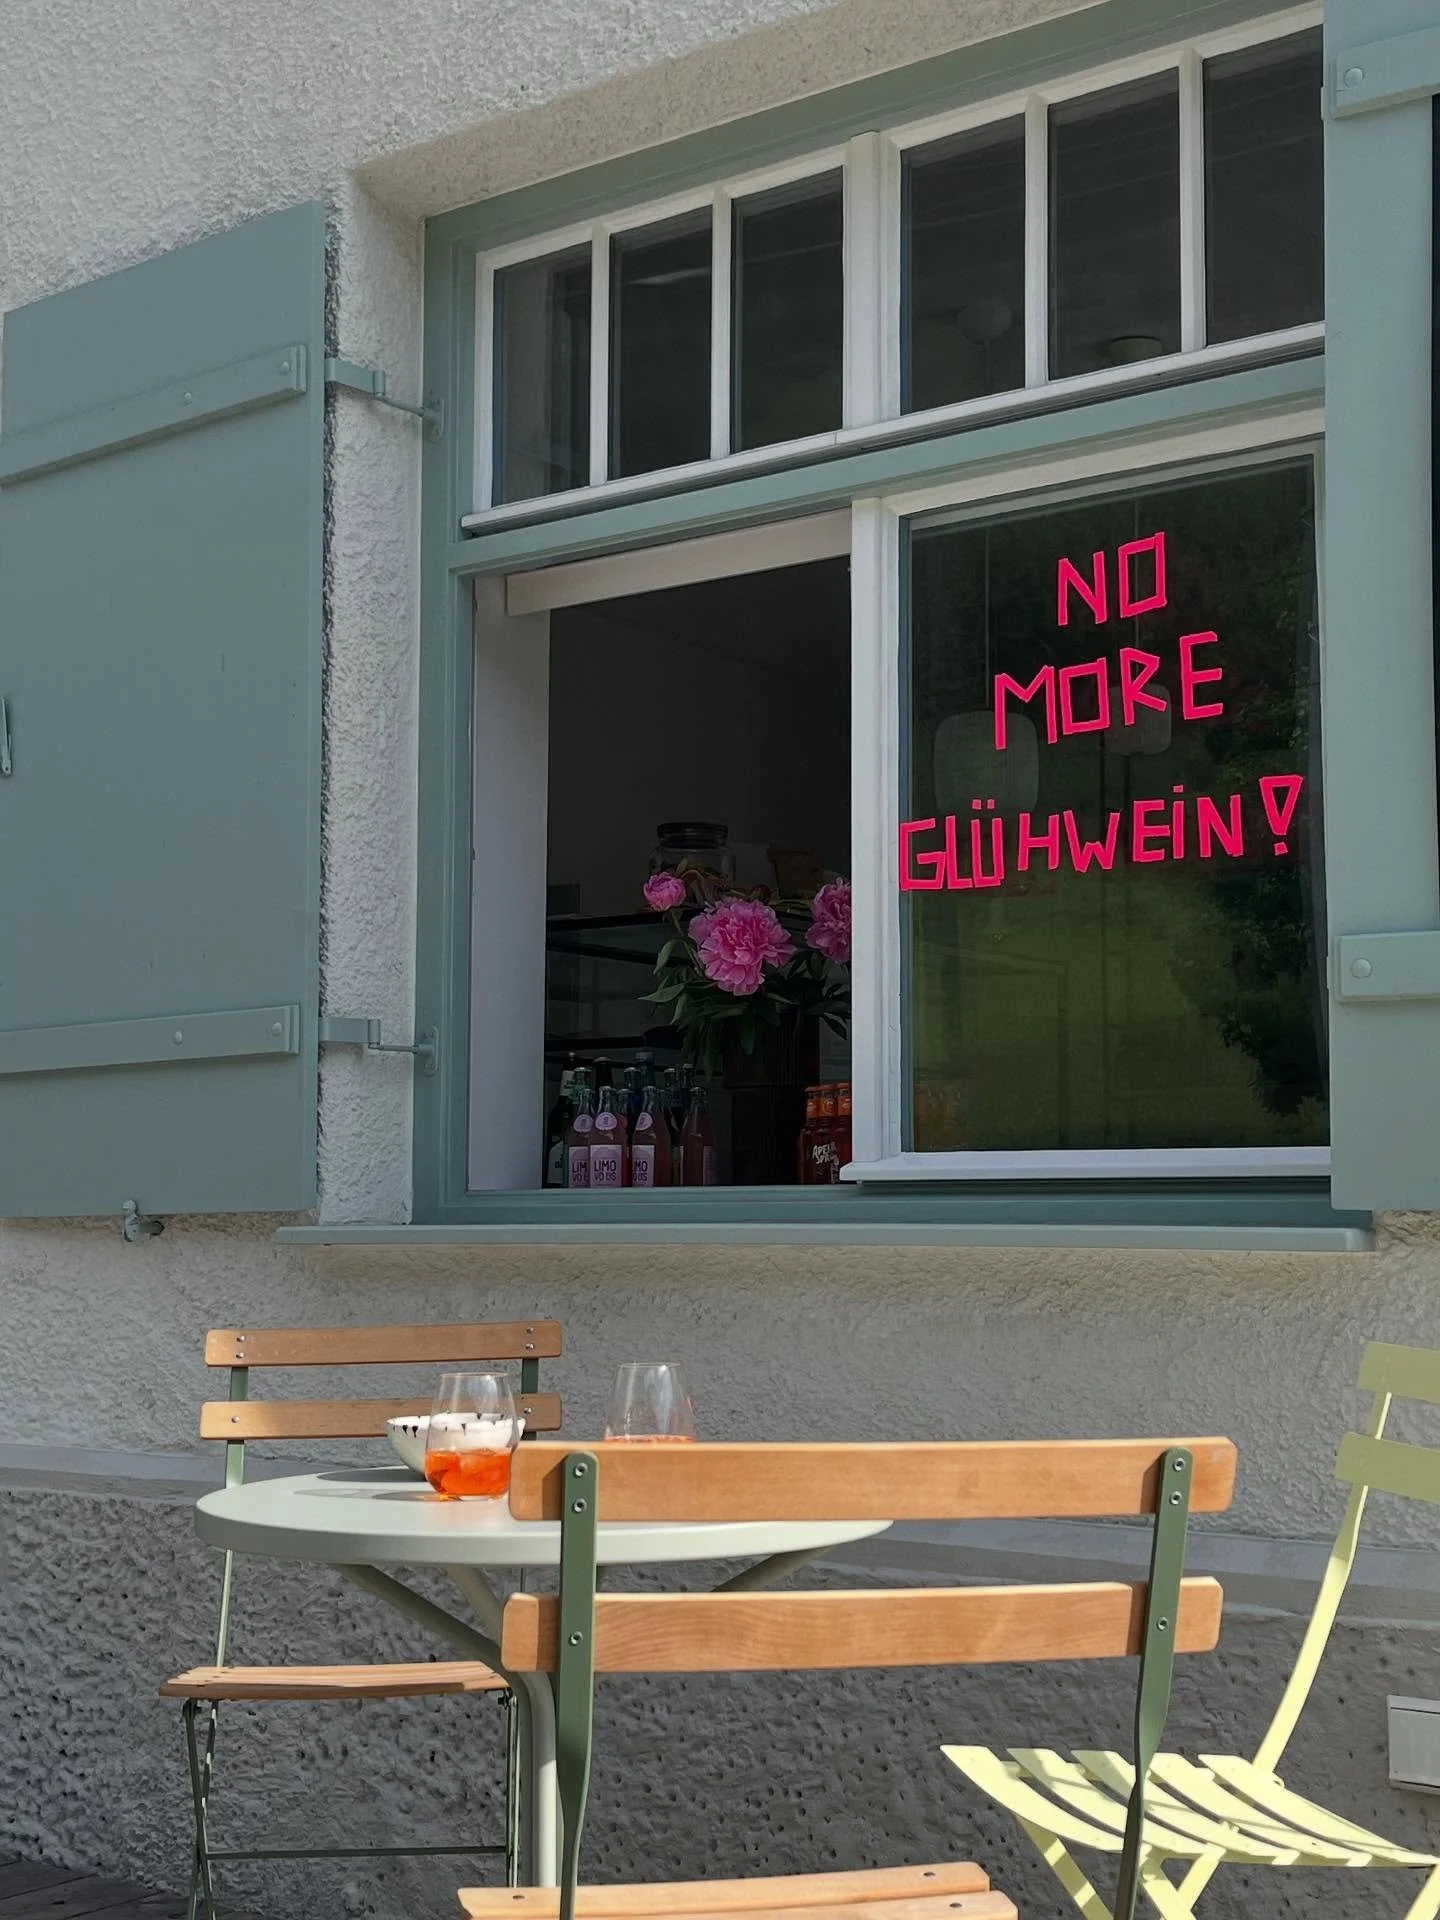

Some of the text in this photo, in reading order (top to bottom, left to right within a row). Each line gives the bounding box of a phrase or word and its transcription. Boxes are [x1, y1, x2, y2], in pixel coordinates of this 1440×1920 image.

[1056, 531, 1168, 626] NO
[994, 630, 1224, 750] MORE
[572, 1161, 587, 1173] LIM
[594, 1159, 617, 1172] LIMO
